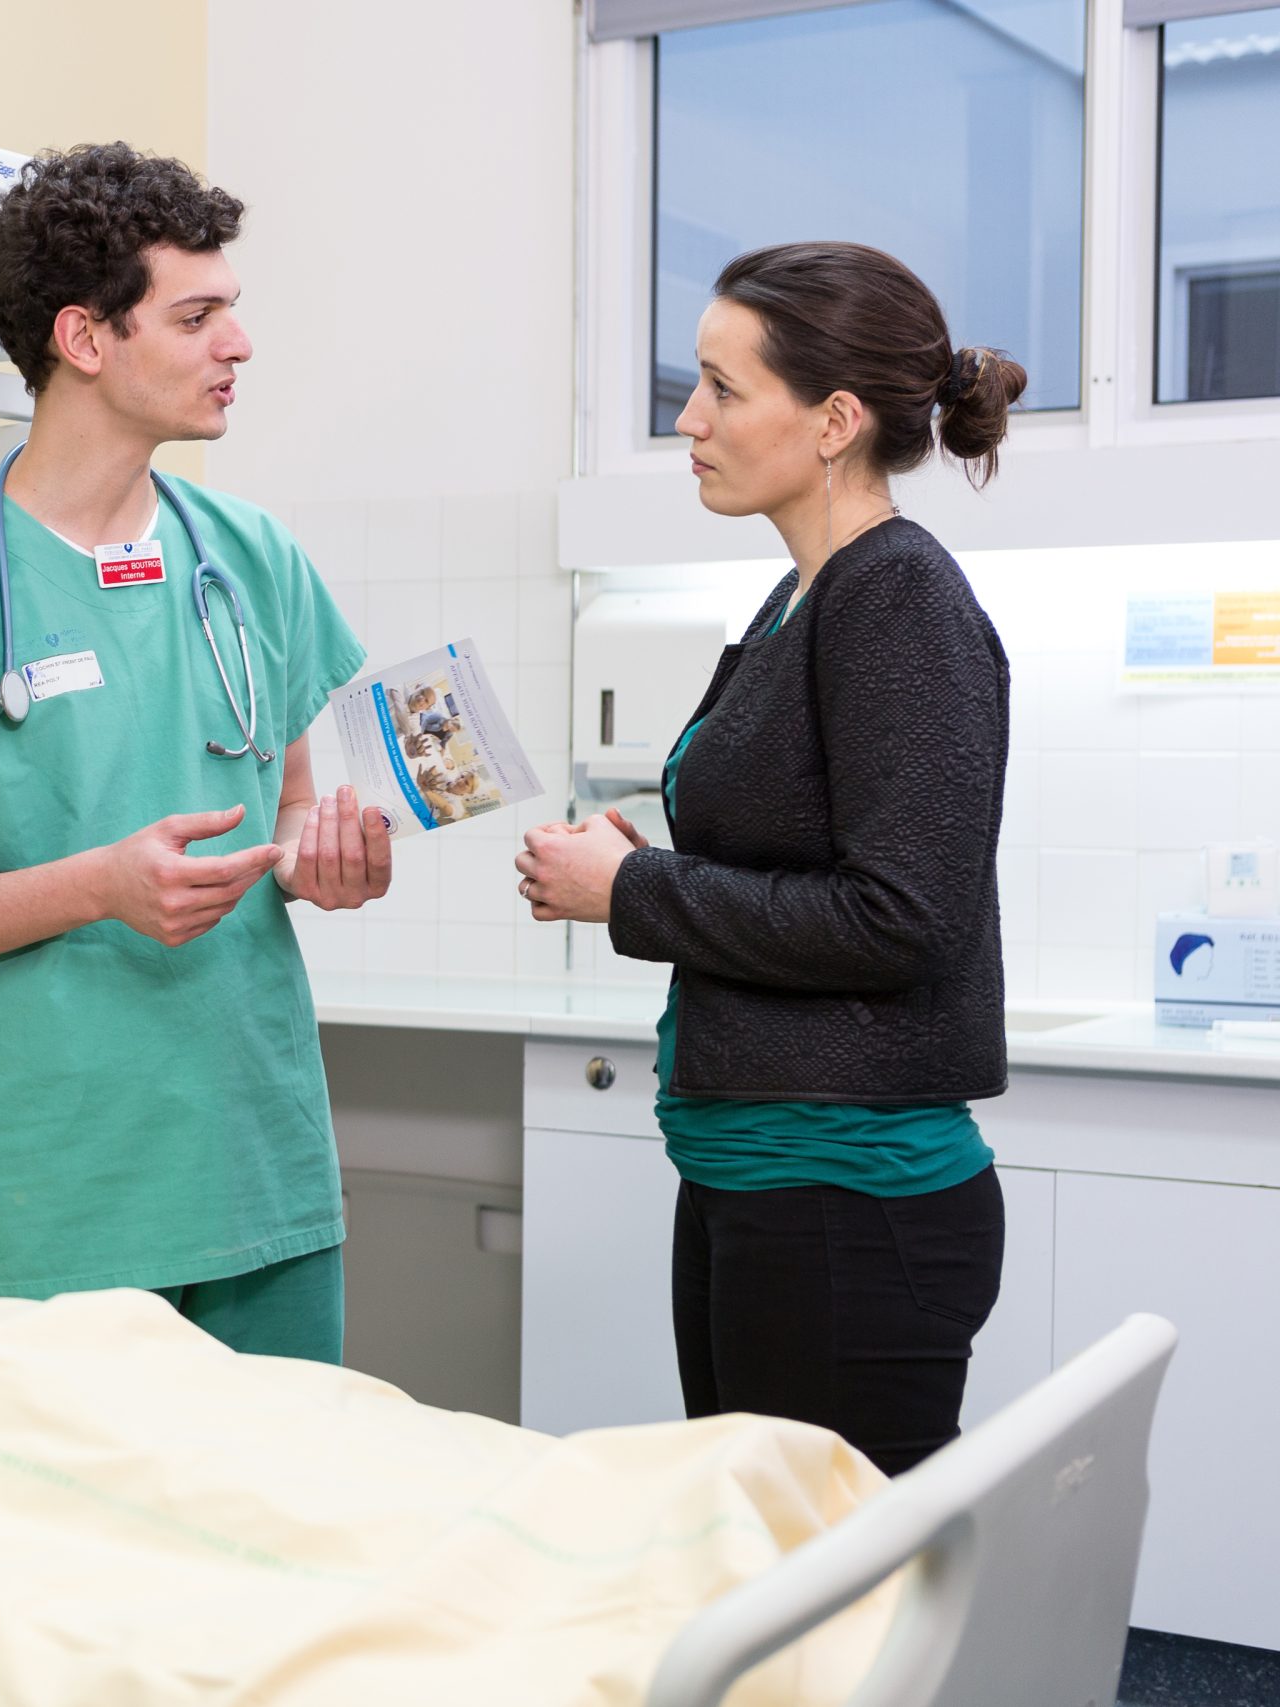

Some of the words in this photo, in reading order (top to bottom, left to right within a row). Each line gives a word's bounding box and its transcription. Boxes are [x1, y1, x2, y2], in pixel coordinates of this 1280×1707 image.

[102, 564, 129, 573] Jacques
[131, 560, 161, 570] BOUTROS
[120, 572, 146, 580] Interne
[387, 733, 395, 749] heart
[393, 754, 403, 774] beating
